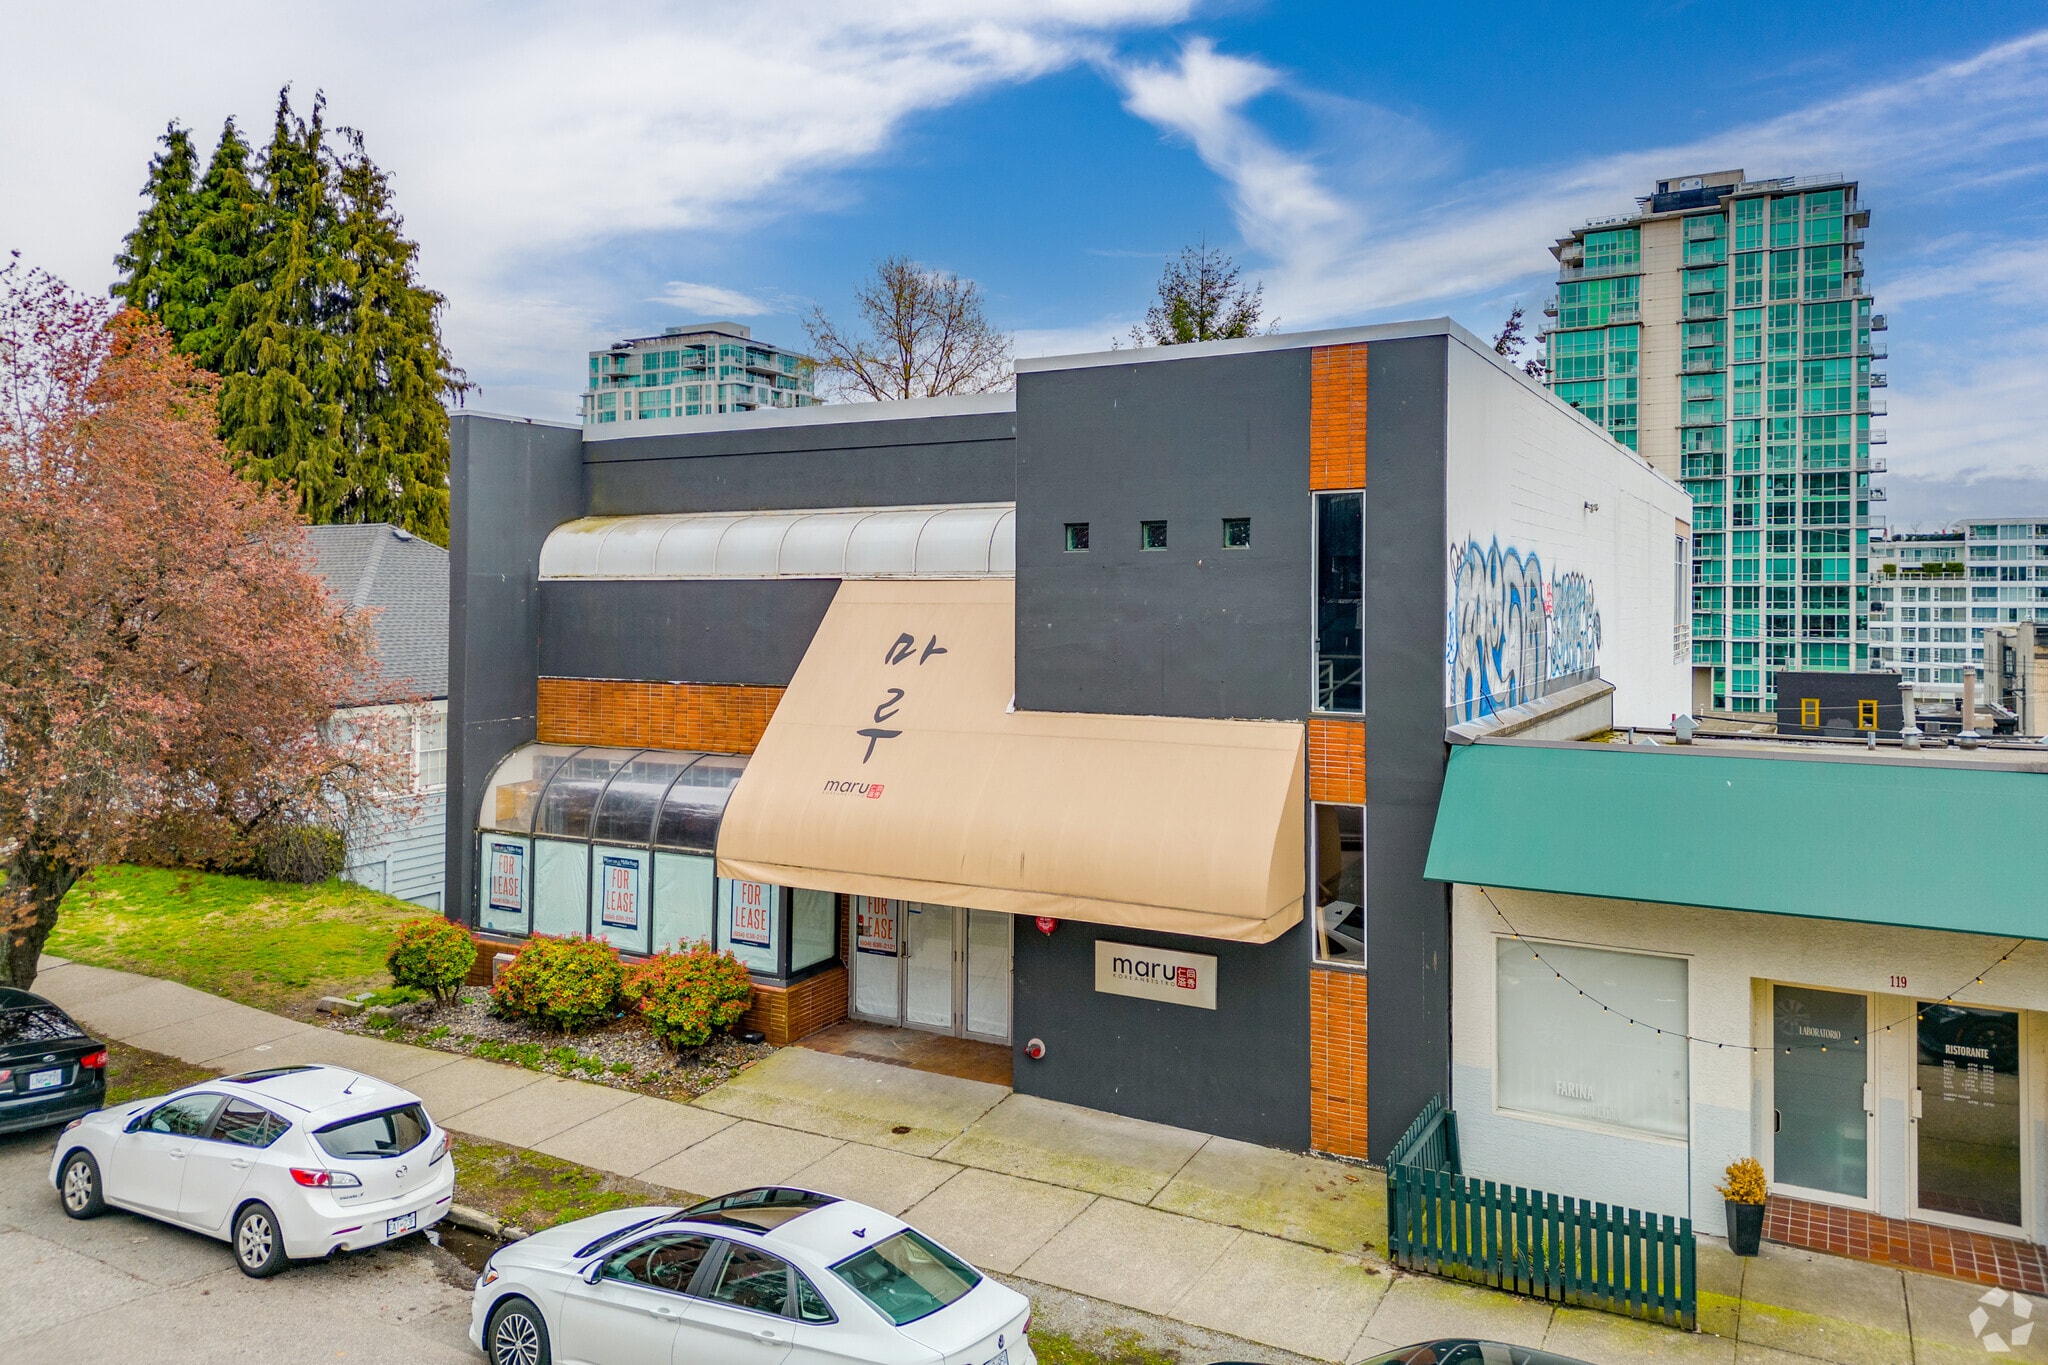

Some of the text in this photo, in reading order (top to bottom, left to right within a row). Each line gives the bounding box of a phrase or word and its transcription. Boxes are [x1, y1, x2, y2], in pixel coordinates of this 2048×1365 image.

[824, 780, 870, 793] maru
[499, 855, 514, 874] FOR
[494, 876, 519, 897] LEASE
[612, 869, 629, 889] FOR
[606, 890, 634, 913] LEASE
[742, 883, 761, 905] FOR
[736, 906, 766, 930] LEASE
[1113, 957, 1176, 980] maru
[1890, 975, 1907, 988] 119
[1799, 1026, 1841, 1040] LABORATORIO
[1945, 1044, 1989, 1059] RISTORANTE
[1556, 1080, 1594, 1101] FARINA
